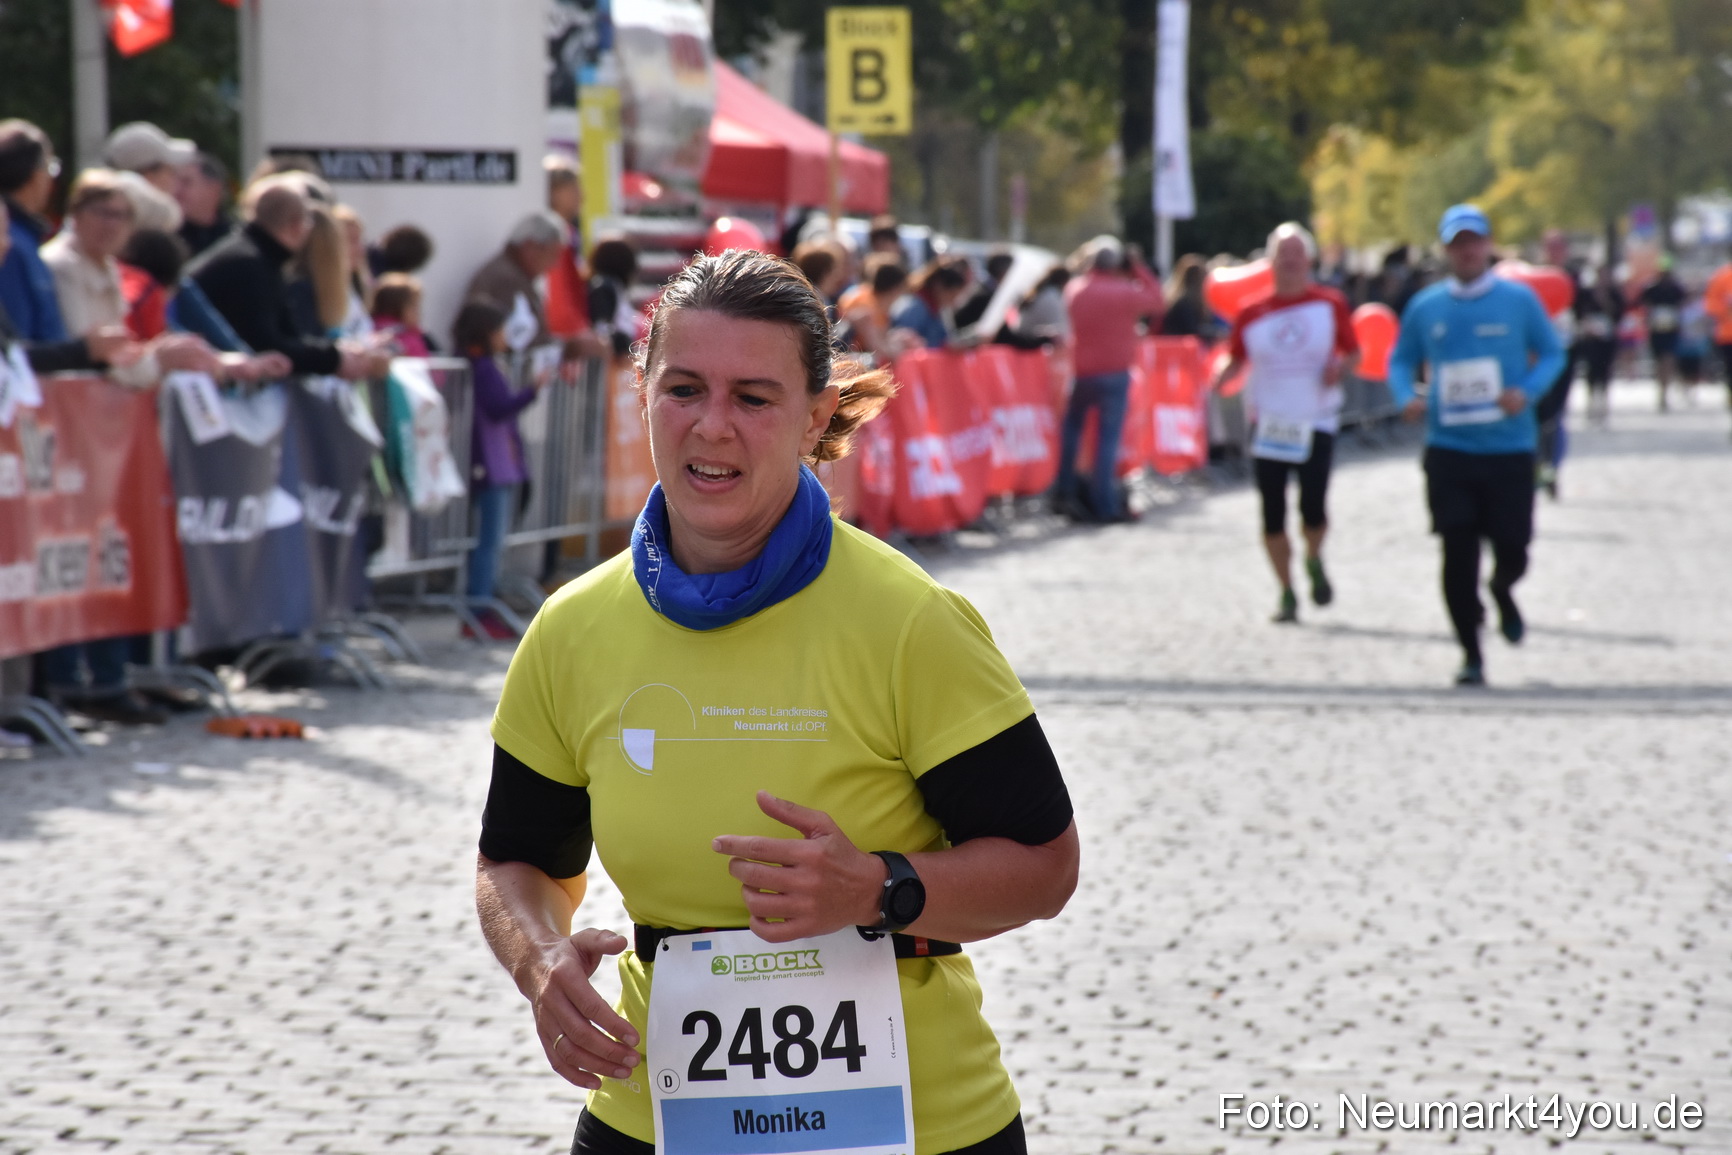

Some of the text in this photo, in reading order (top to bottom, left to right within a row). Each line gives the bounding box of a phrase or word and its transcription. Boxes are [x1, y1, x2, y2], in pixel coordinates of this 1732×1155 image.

[850, 47, 888, 104] B
[701, 706, 828, 718] Kliniken des Landkreises
[734, 720, 788, 731] Neumarkt
[733, 949, 823, 975] BOCK
[734, 974, 761, 982] inspired
[772, 972, 792, 980] smart
[793, 969, 825, 978] concepts
[681, 1000, 867, 1083] 2484
[664, 1075, 673, 1088] D
[732, 1107, 826, 1135] Monika
